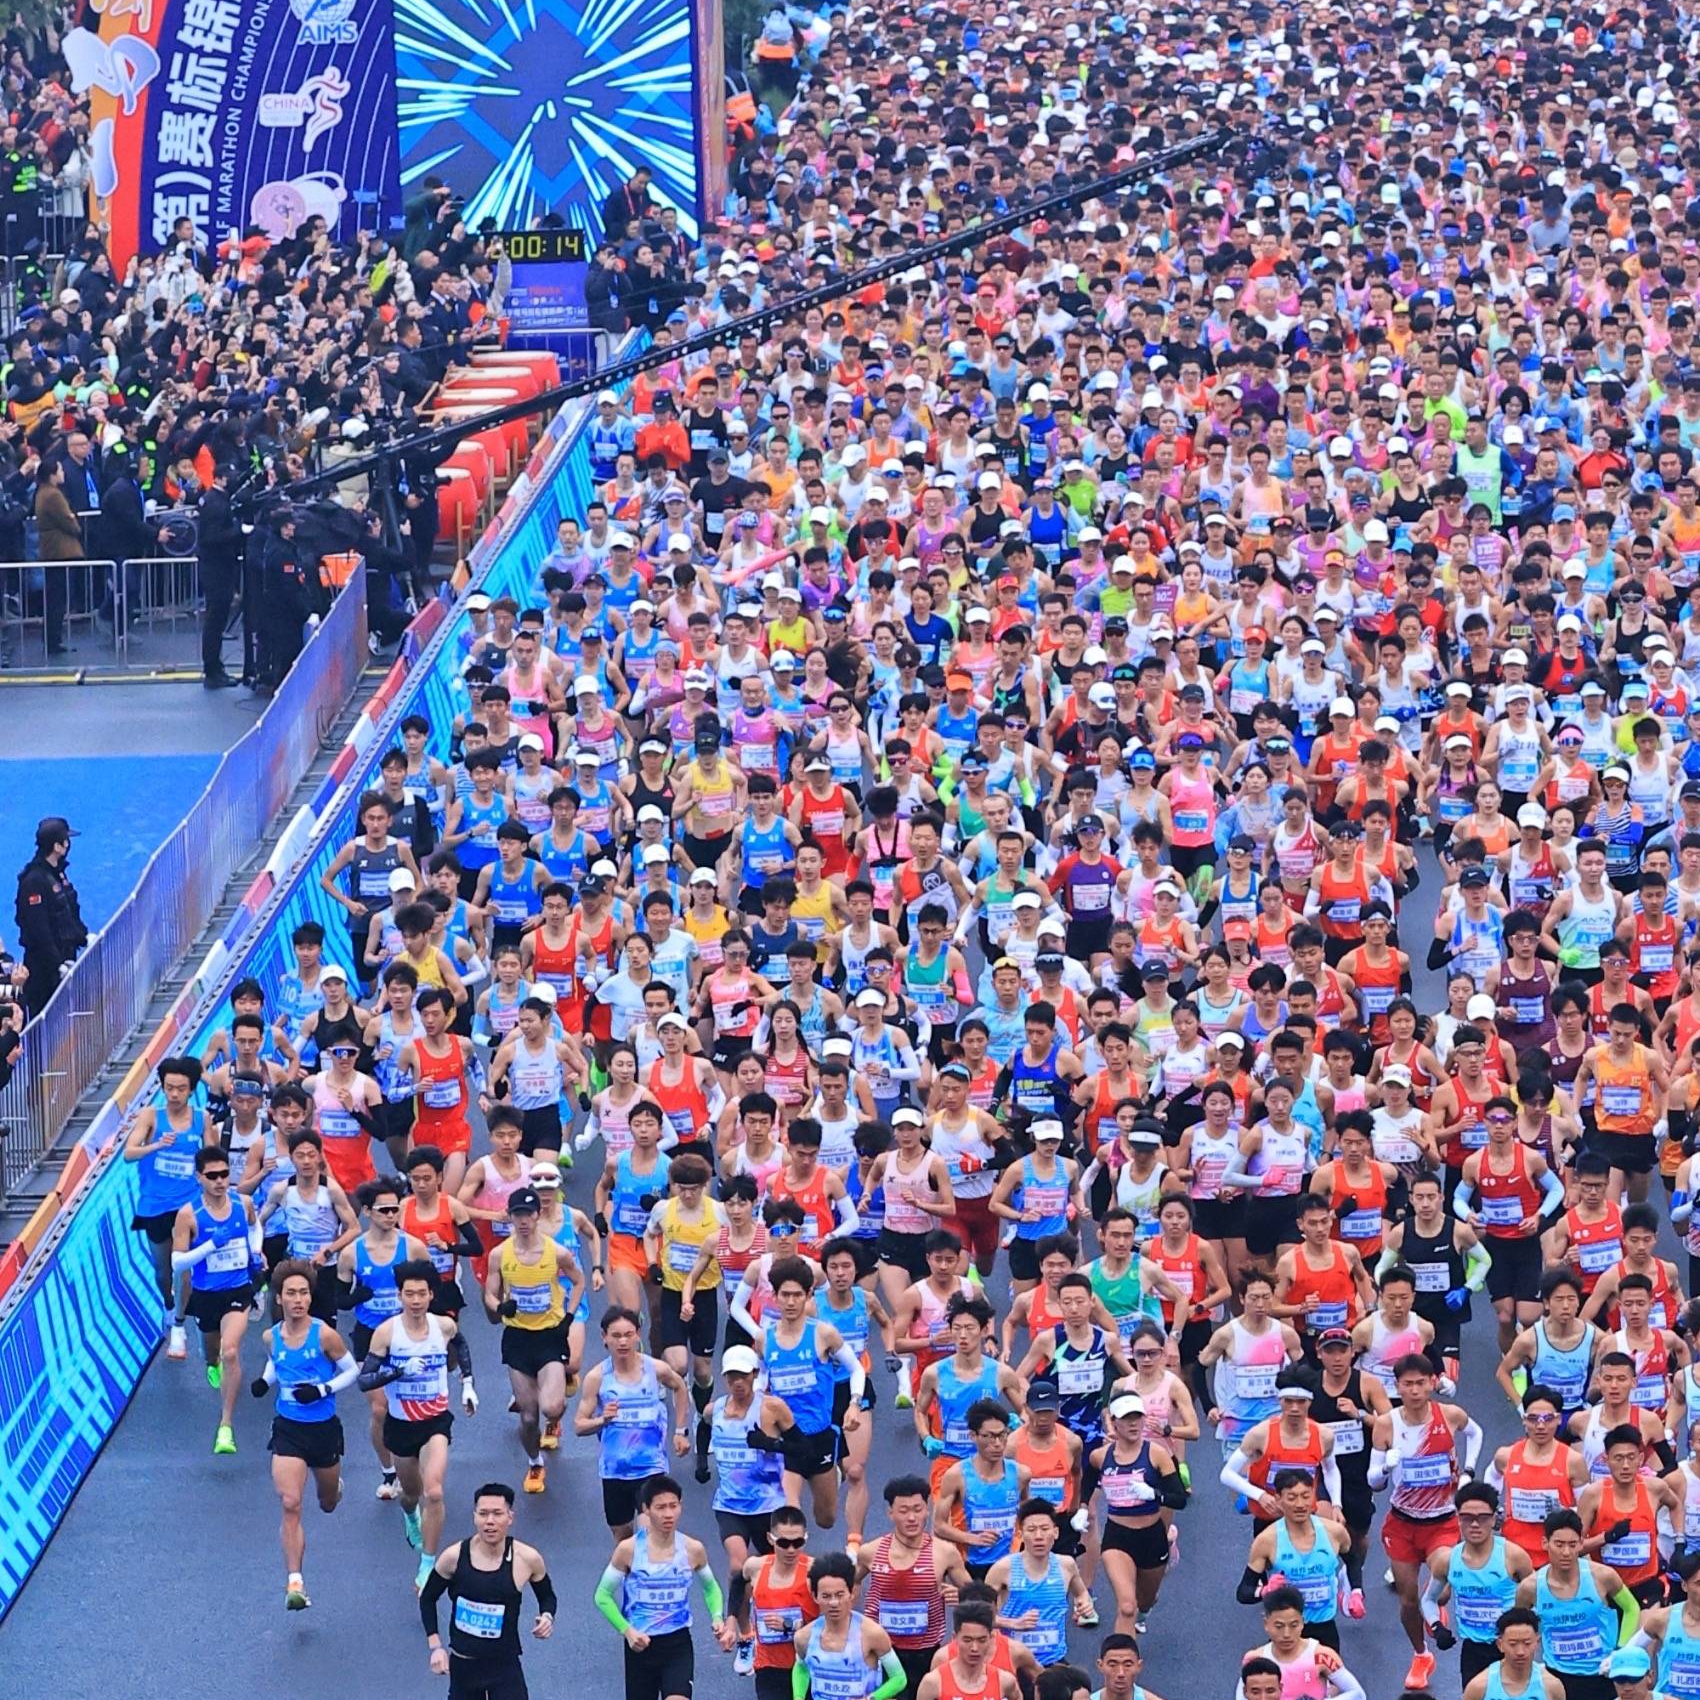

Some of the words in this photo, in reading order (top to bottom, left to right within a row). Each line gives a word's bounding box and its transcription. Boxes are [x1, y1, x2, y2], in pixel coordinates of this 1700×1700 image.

[300, 22, 357, 43] AIMS
[263, 98, 310, 109] CHINA
[220, 109, 243, 214] MARATHON
[490, 235, 579, 259] :00:14
